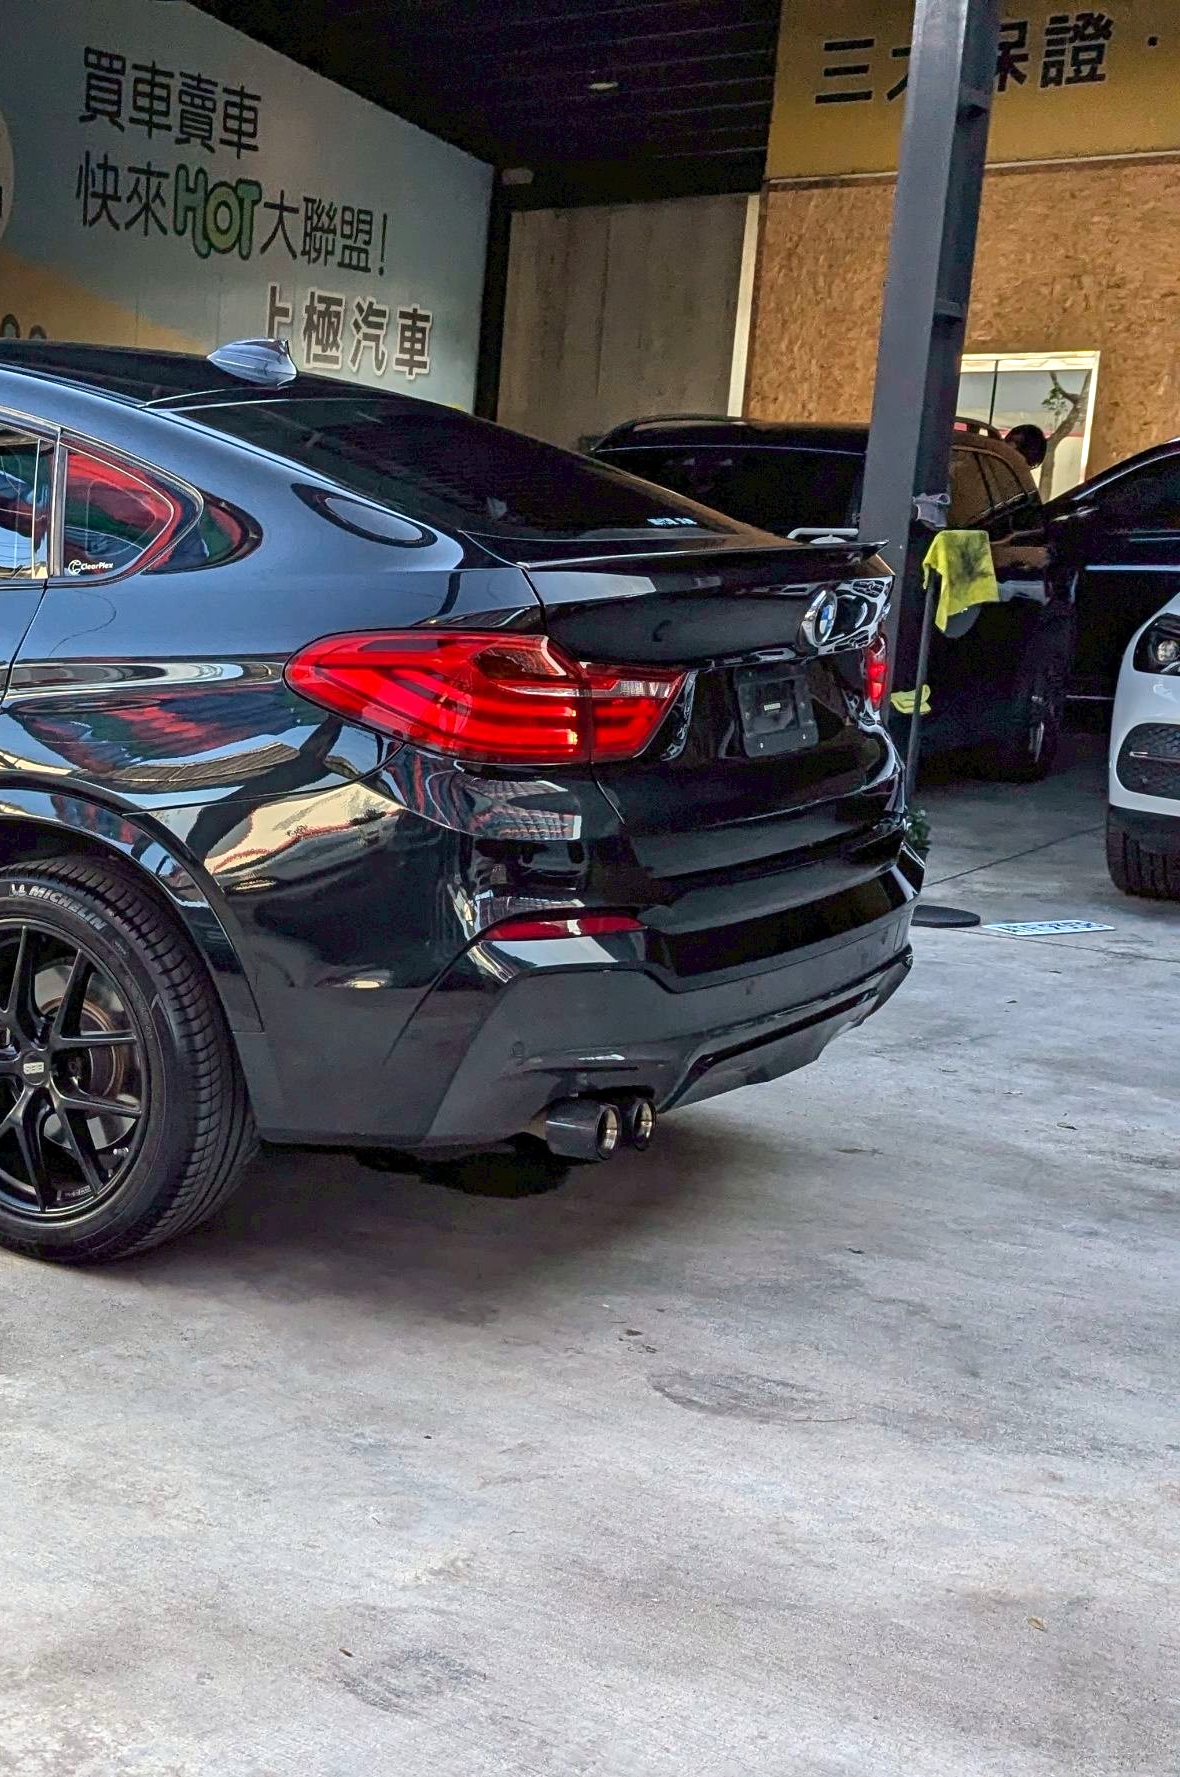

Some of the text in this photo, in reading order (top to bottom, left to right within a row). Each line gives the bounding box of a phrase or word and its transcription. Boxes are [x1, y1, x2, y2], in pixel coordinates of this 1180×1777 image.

[78, 46, 262, 158] 買車賣車
[28, 885, 108, 930] MICHELIN
